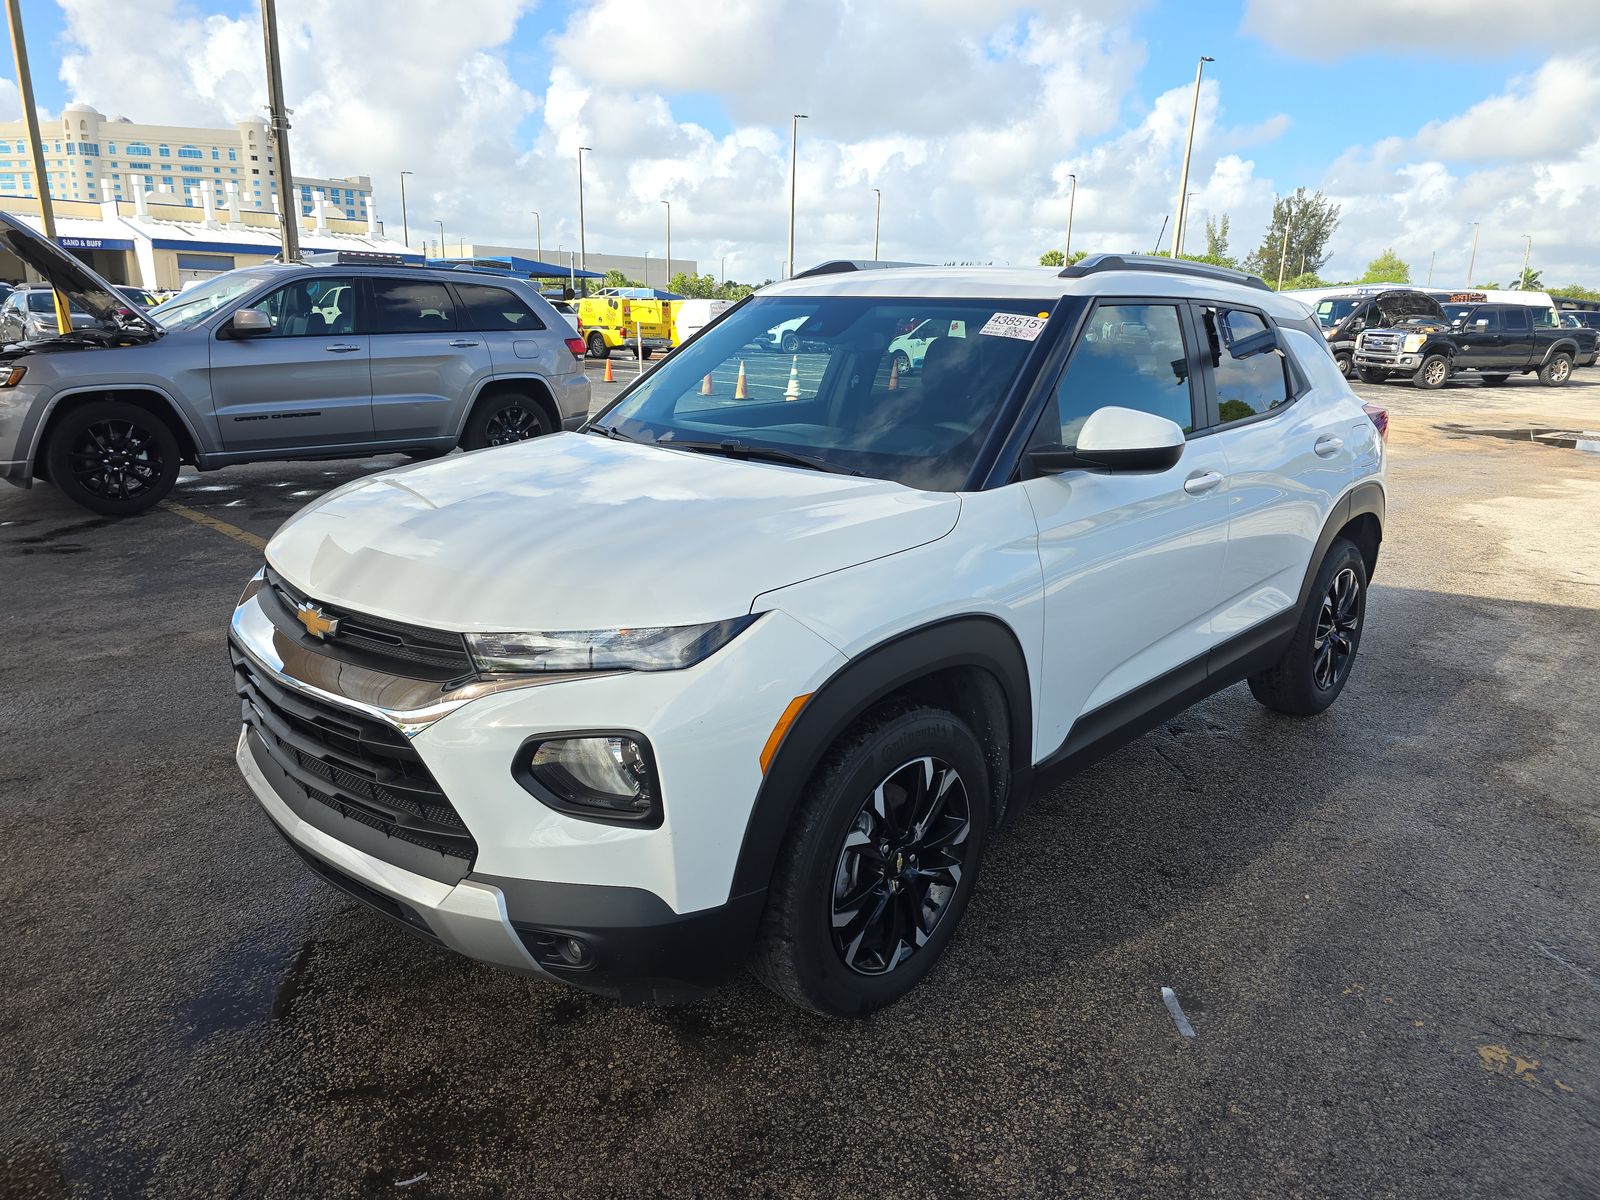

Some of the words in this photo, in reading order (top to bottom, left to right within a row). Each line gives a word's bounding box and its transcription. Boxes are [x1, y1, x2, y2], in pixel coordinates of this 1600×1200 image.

[62, 238, 80, 246] SAND
[80, 239, 86, 247] &
[86, 240, 102, 248] BUFF
[992, 315, 1045, 330] 4385151
